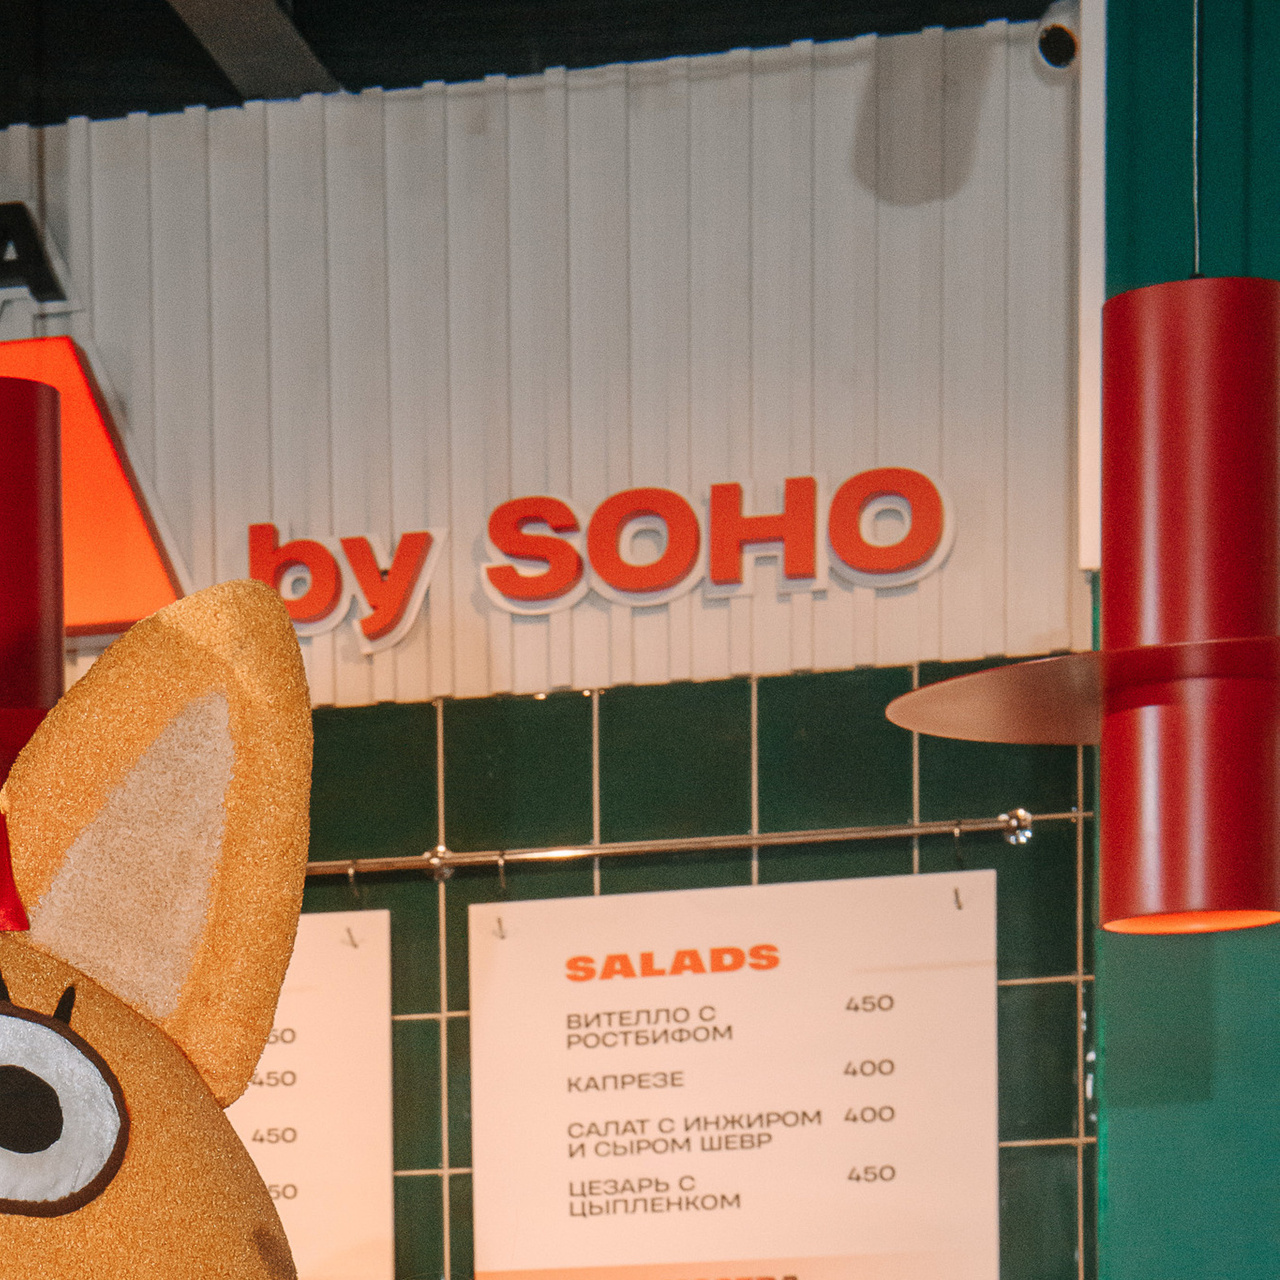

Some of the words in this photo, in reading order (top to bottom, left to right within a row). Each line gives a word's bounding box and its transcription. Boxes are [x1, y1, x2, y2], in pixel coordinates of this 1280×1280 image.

[248, 522, 433, 642] by
[485, 466, 945, 602] SOHO
[565, 943, 781, 983] SALADS
[566, 1006, 691, 1031] ВИТЕЛЛО
[697, 1004, 717, 1023] С
[845, 993, 895, 1014] 450
[267, 1027, 297, 1046] 50
[566, 1024, 734, 1050] РОСТБИФОМ
[250, 1070, 298, 1088] 450
[567, 1070, 685, 1094] КАПРЕЗЕ
[843, 1058, 896, 1078] 400
[251, 1126, 298, 1145] 450
[567, 1118, 651, 1140] САЛАТ
[657, 1116, 676, 1135] С
[683, 1109, 823, 1132] ИНЖИРОМ
[843, 1104, 896, 1124] 400
[568, 1142, 587, 1159] И
[593, 1135, 692, 1158] СЫРОМ
[699, 1131, 773, 1152] ШЕВР
[268, 1183, 299, 1202] 50
[568, 1177, 670, 1199] ЦЕЗАРЬ
[677, 1174, 697, 1193] С
[846, 1163, 898, 1184] 450
[568, 1192, 742, 1220] ЦЫПЛЕНКОМ
